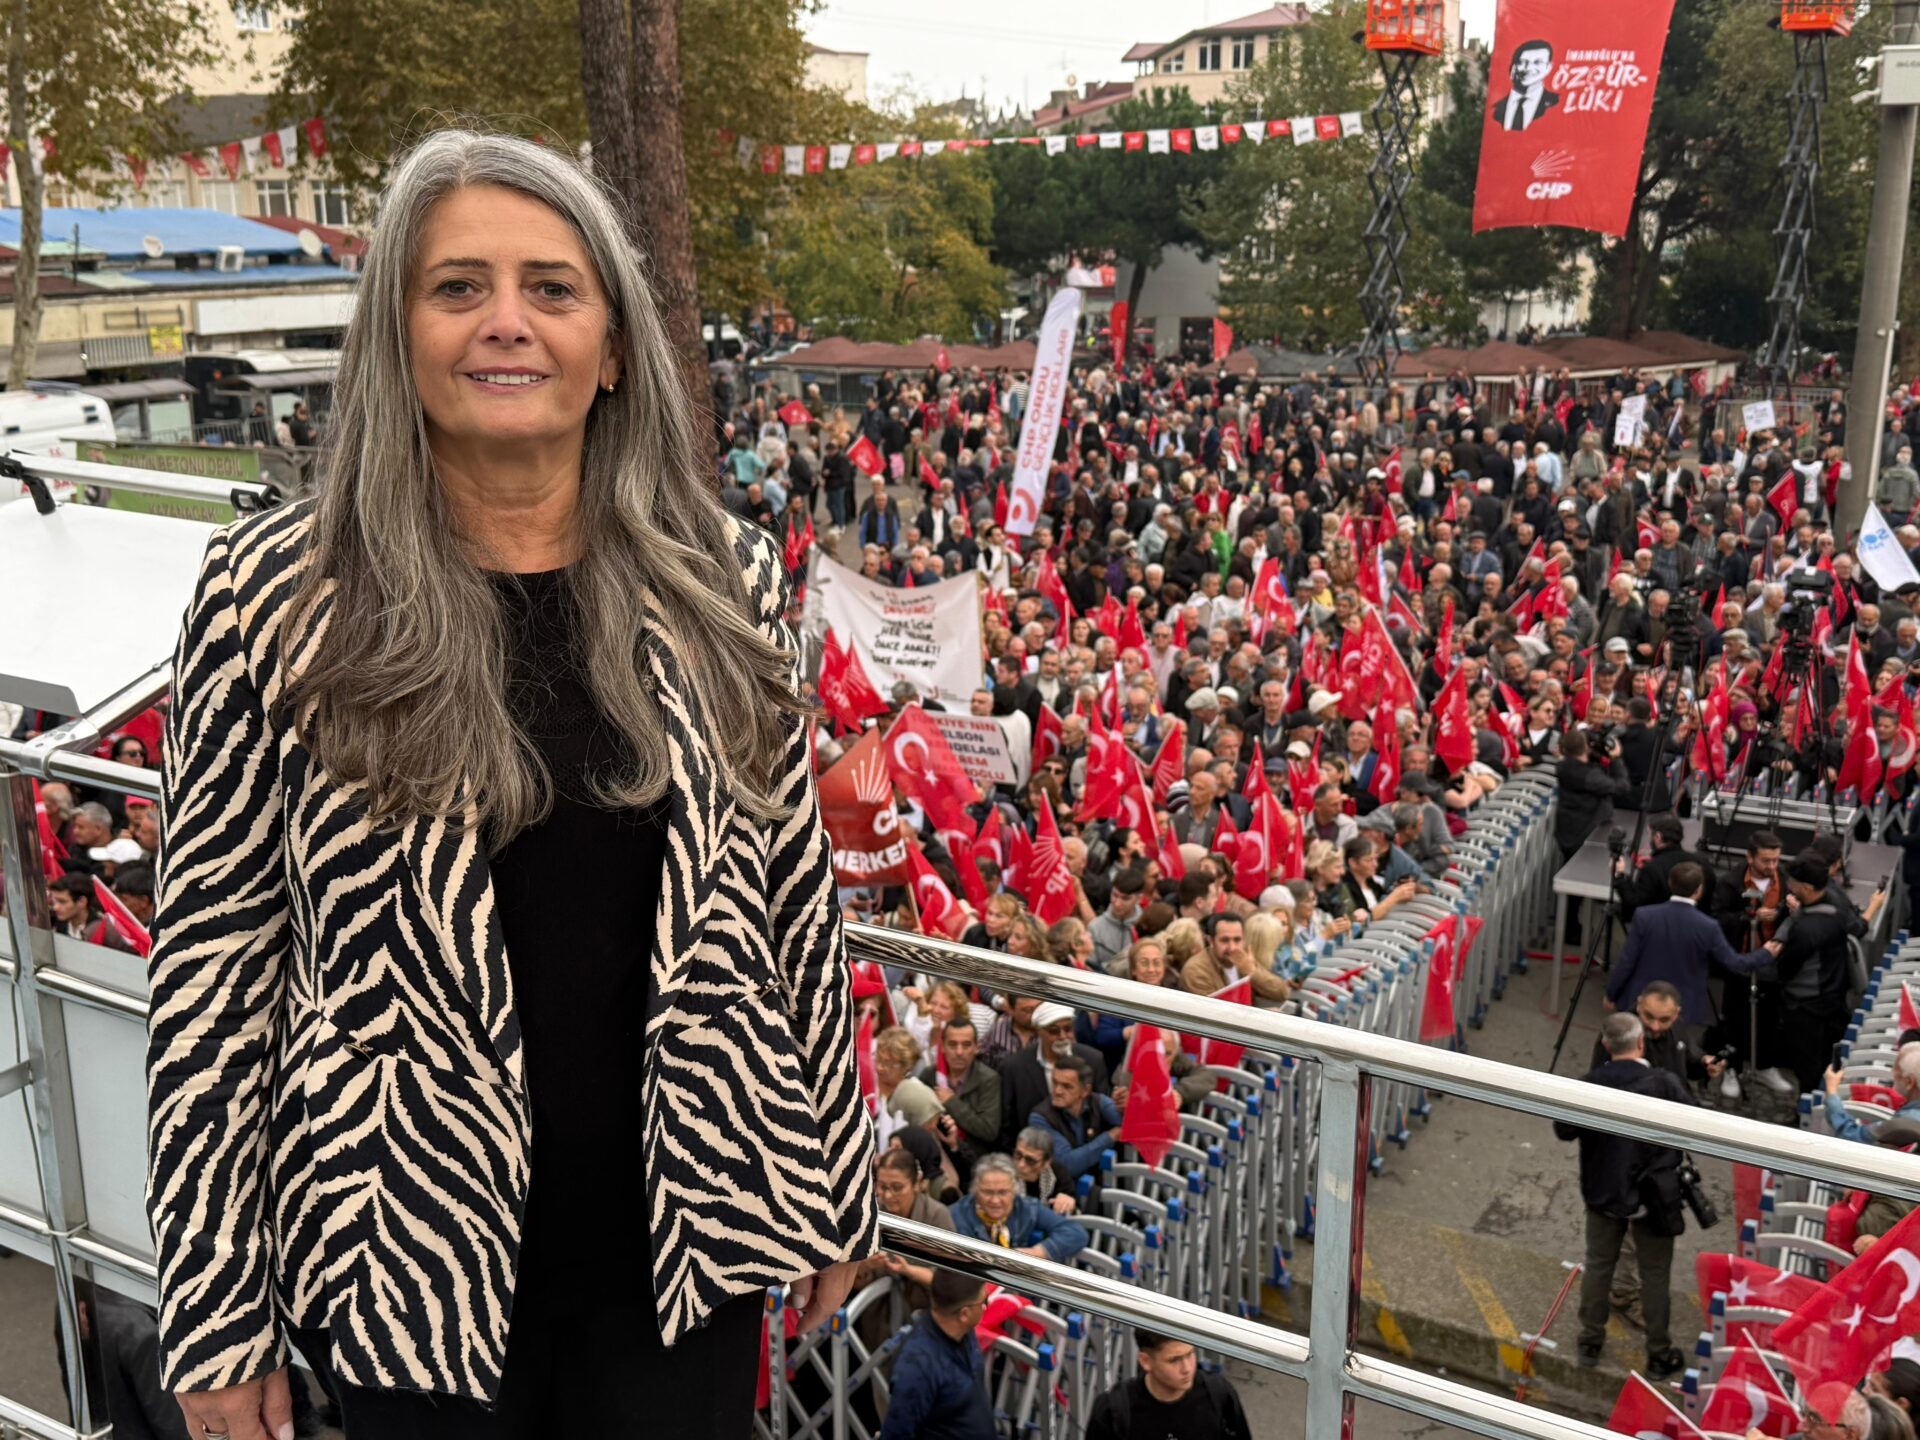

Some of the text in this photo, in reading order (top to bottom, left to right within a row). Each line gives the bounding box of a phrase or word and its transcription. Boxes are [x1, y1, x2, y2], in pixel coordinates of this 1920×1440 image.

[1552, 61, 1648, 90] ÖZGÜR-
[1526, 182, 1573, 199] CHP
[1021, 366, 1050, 469] CHP ORDU
[942, 729, 985, 743] ELSON
[949, 742, 1001, 756] DELASI
